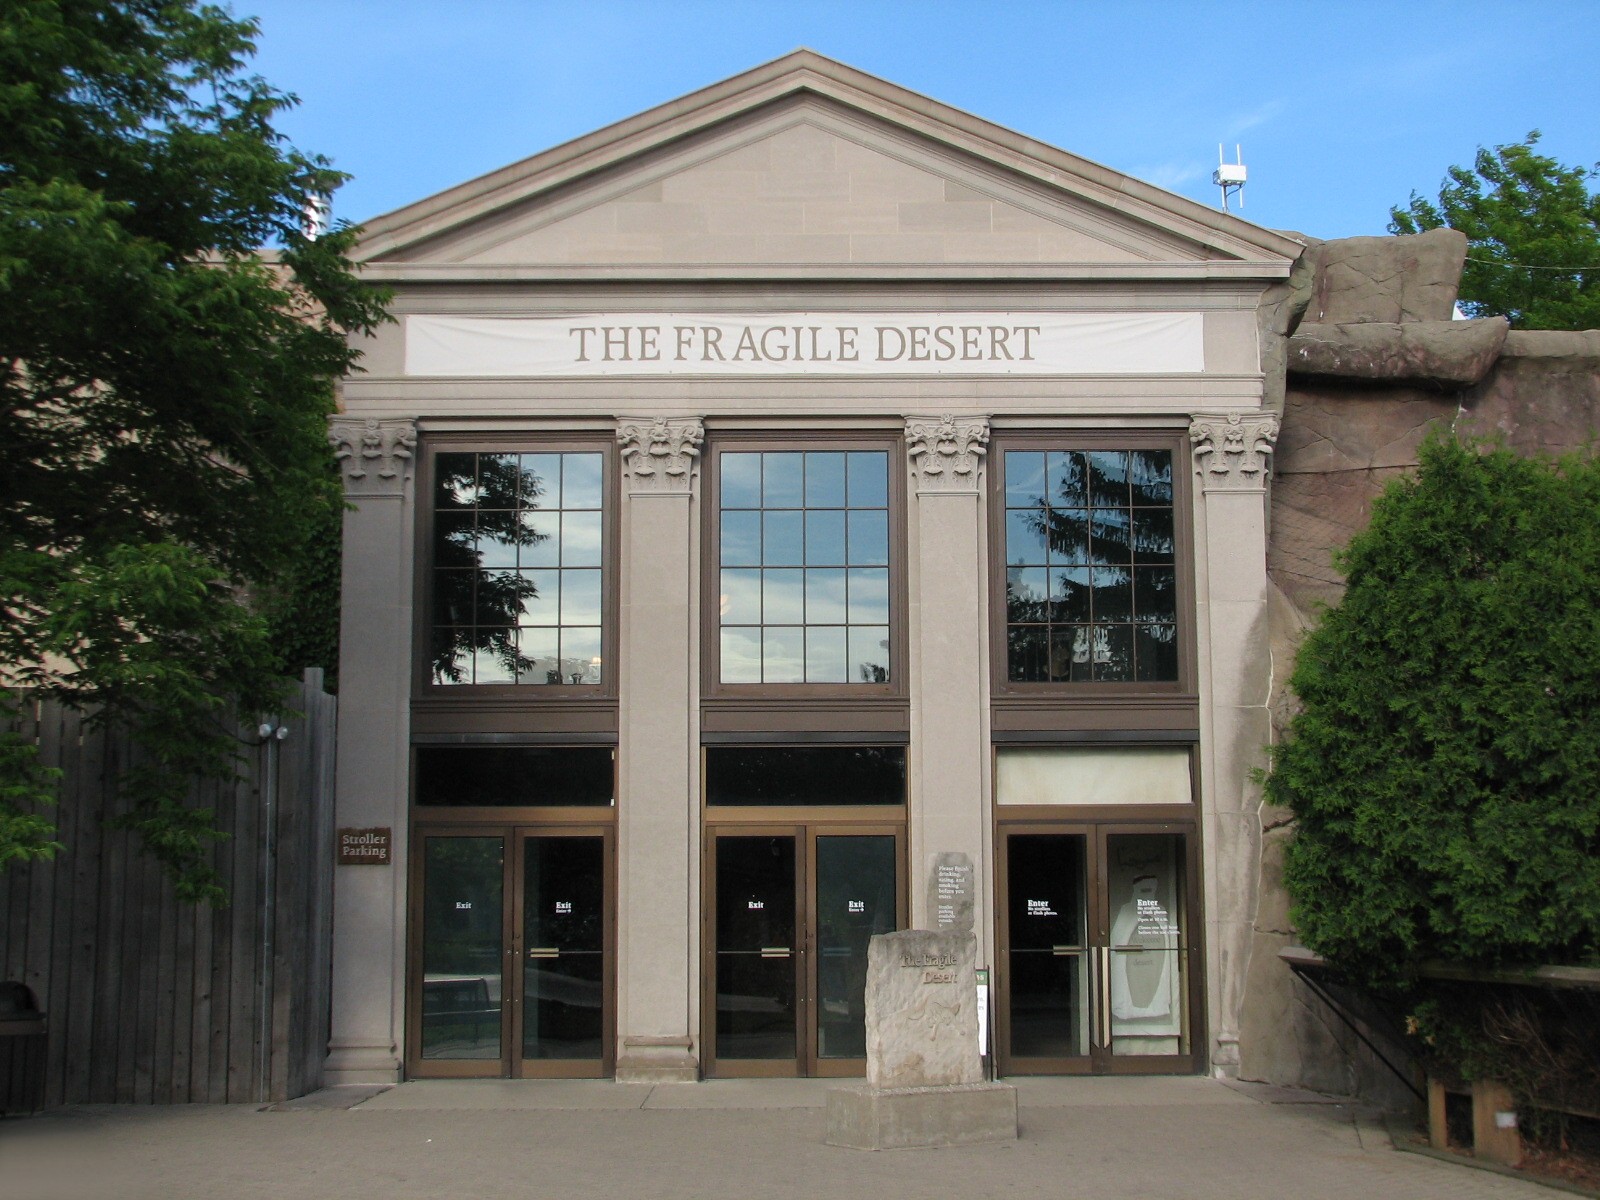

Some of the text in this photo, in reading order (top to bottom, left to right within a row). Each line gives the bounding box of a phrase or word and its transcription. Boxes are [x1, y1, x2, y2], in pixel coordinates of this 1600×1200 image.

[569, 325, 1041, 362] THE FRAGILE DESERT
[342, 833, 386, 844] Stroller
[343, 845, 386, 859] Parking
[456, 901, 472, 909] Exit
[555, 901, 572, 909] Exit
[748, 901, 764, 909] Exit
[848, 900, 865, 908] Exit
[1027, 899, 1049, 907] Enter
[1137, 898, 1158, 906] Enter
[922, 971, 958, 984] Desert
